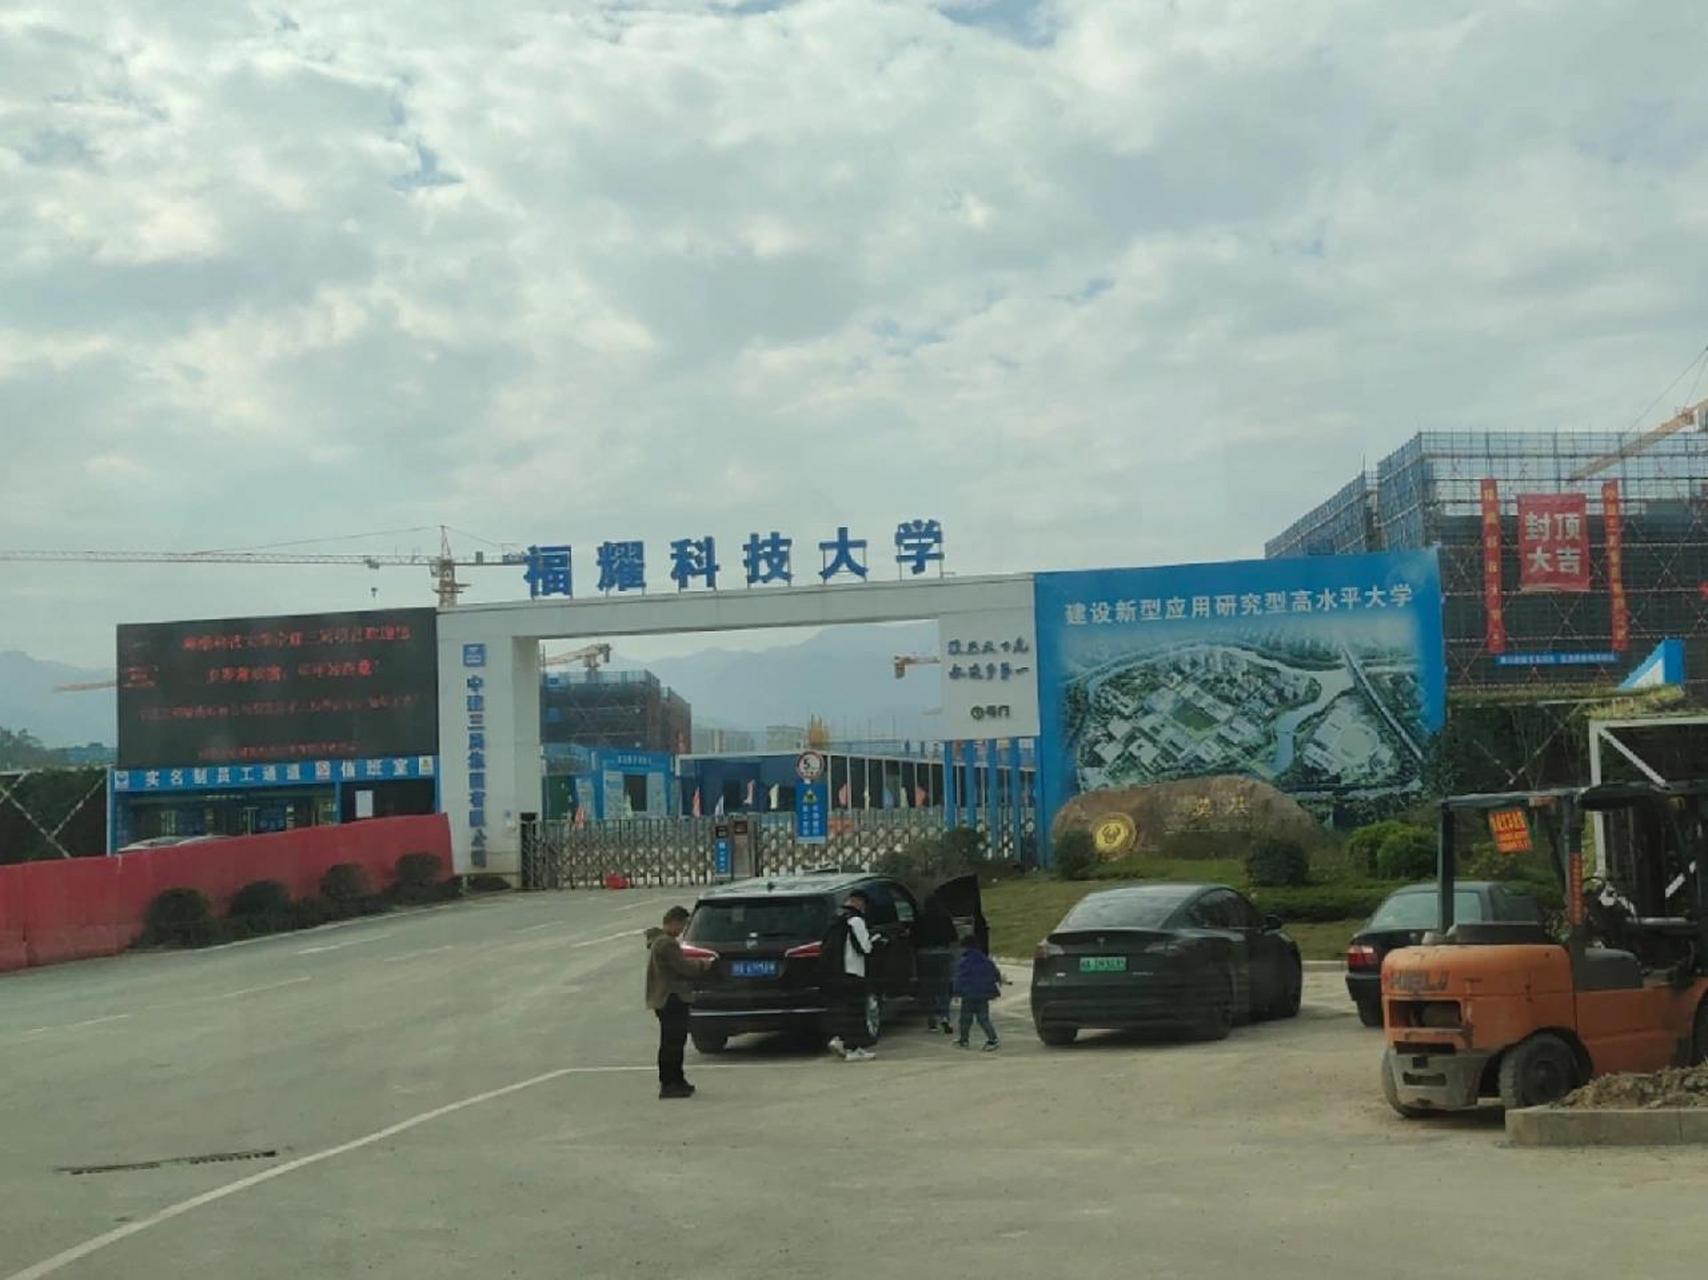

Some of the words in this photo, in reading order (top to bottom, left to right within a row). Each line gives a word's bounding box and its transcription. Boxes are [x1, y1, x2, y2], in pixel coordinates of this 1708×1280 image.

[1525, 511, 1581, 541] 封顶
[523, 519, 945, 596] 福耀科技大学
[1526, 545, 1581, 575] 大吉
[1064, 583, 1413, 625] 建设新型应用研究型高水平大学
